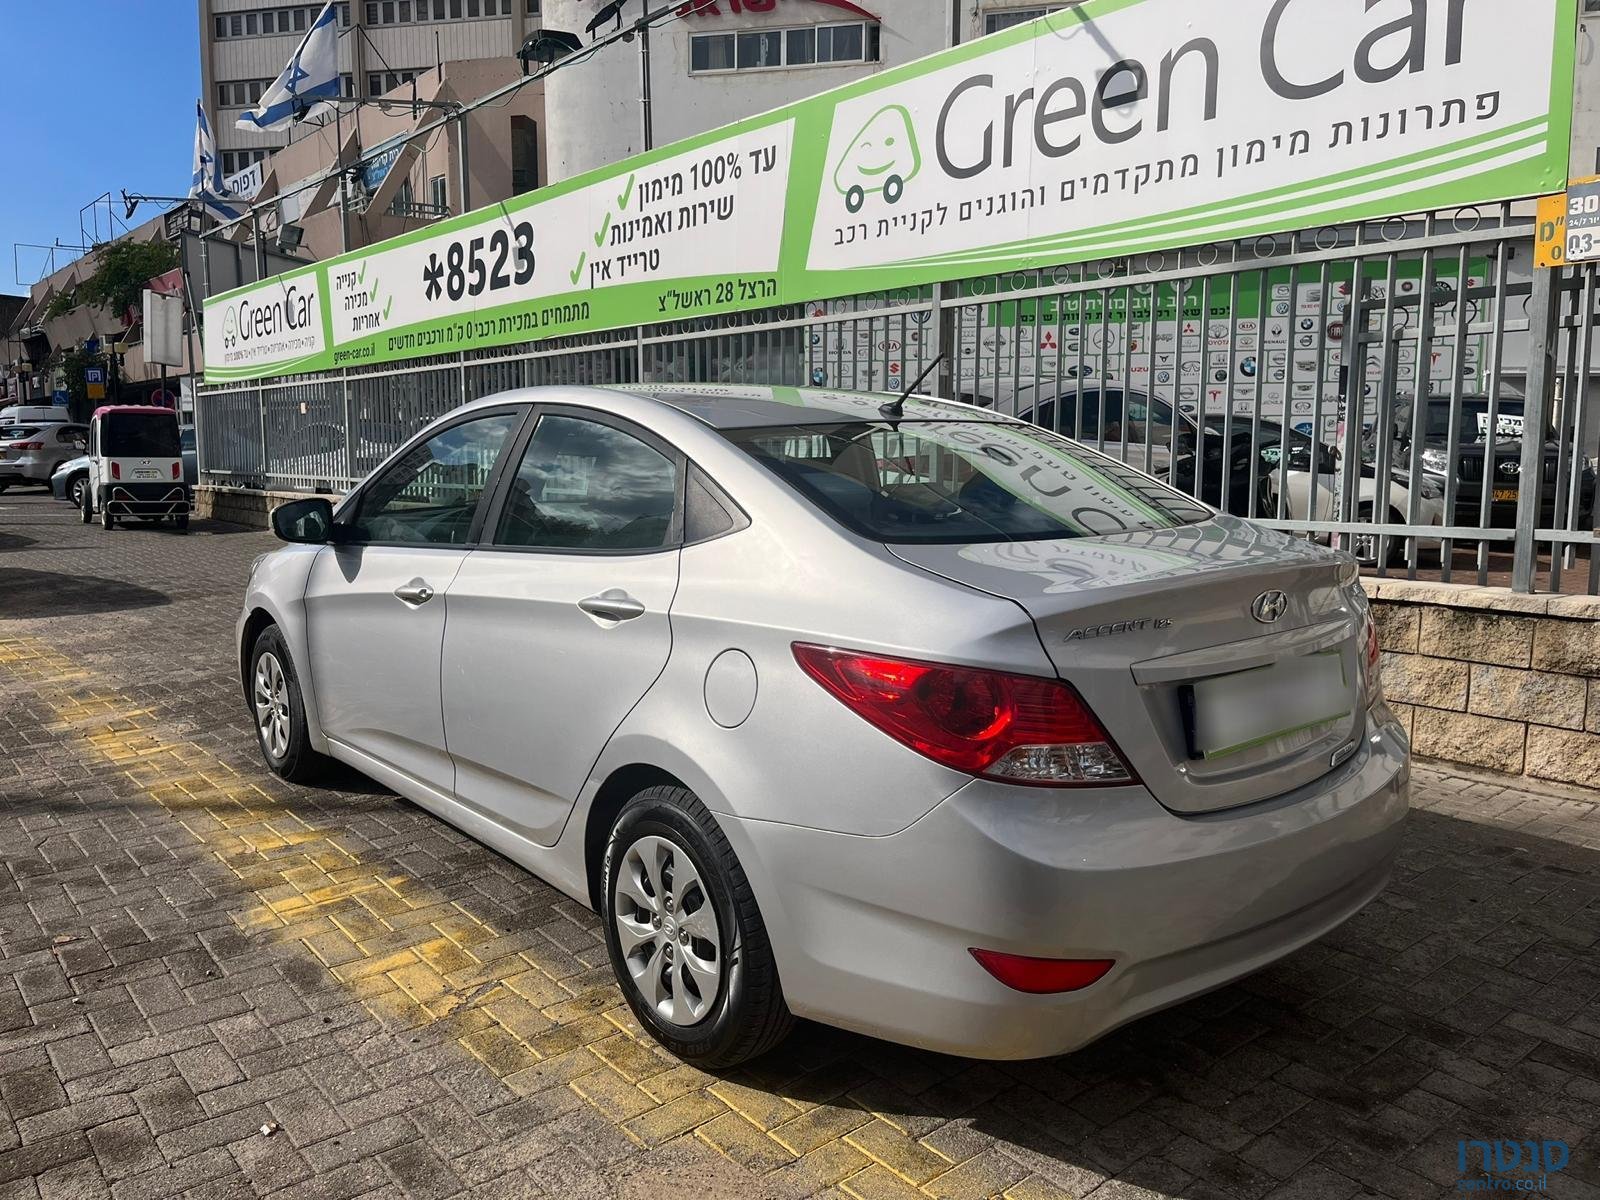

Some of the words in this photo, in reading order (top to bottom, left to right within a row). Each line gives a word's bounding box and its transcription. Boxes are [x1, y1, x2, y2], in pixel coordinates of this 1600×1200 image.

[936, 37, 1219, 180] Green
[1260, 0, 1465, 100] Car
[1328, 90, 1500, 148] פתרונות
[749, 145, 777, 175] עד
[1216, 129, 1310, 178] מימון
[232, 169, 256, 195] דפוס
[690, 152, 742, 191] 100%
[1060, 153, 1199, 202] מתקדמים
[639, 172, 683, 212] מימון
[959, 186, 1045, 222] והוגנים
[678, 195, 734, 231] שירות
[877, 202, 948, 235] לקניית
[610, 210, 672, 246] ואמינות
[834, 223, 867, 246] רכב
[590, 259, 612, 289] אין
[617, 248, 660, 277] טרייד
[336, 271, 357, 291] קנייה
[716, 281, 734, 305] 28
[738, 278, 777, 301] הרצל
[240, 300, 282, 341] Green
[286, 285, 314, 330] Car
[344, 291, 368, 311] מכירה
[541, 301, 590, 326] מתמחים
[352, 311, 380, 332] אחריות
[466, 321, 473, 339] 0
[474, 320, 496, 338] רכבי
[498, 313, 539, 334] במכירת
[388, 333, 415, 352] חדשים
[417, 330, 444, 347] ורכבים
[333, 342, 376, 365] green-car.co.il
[1063, 618, 1152, 643] ACCENT
